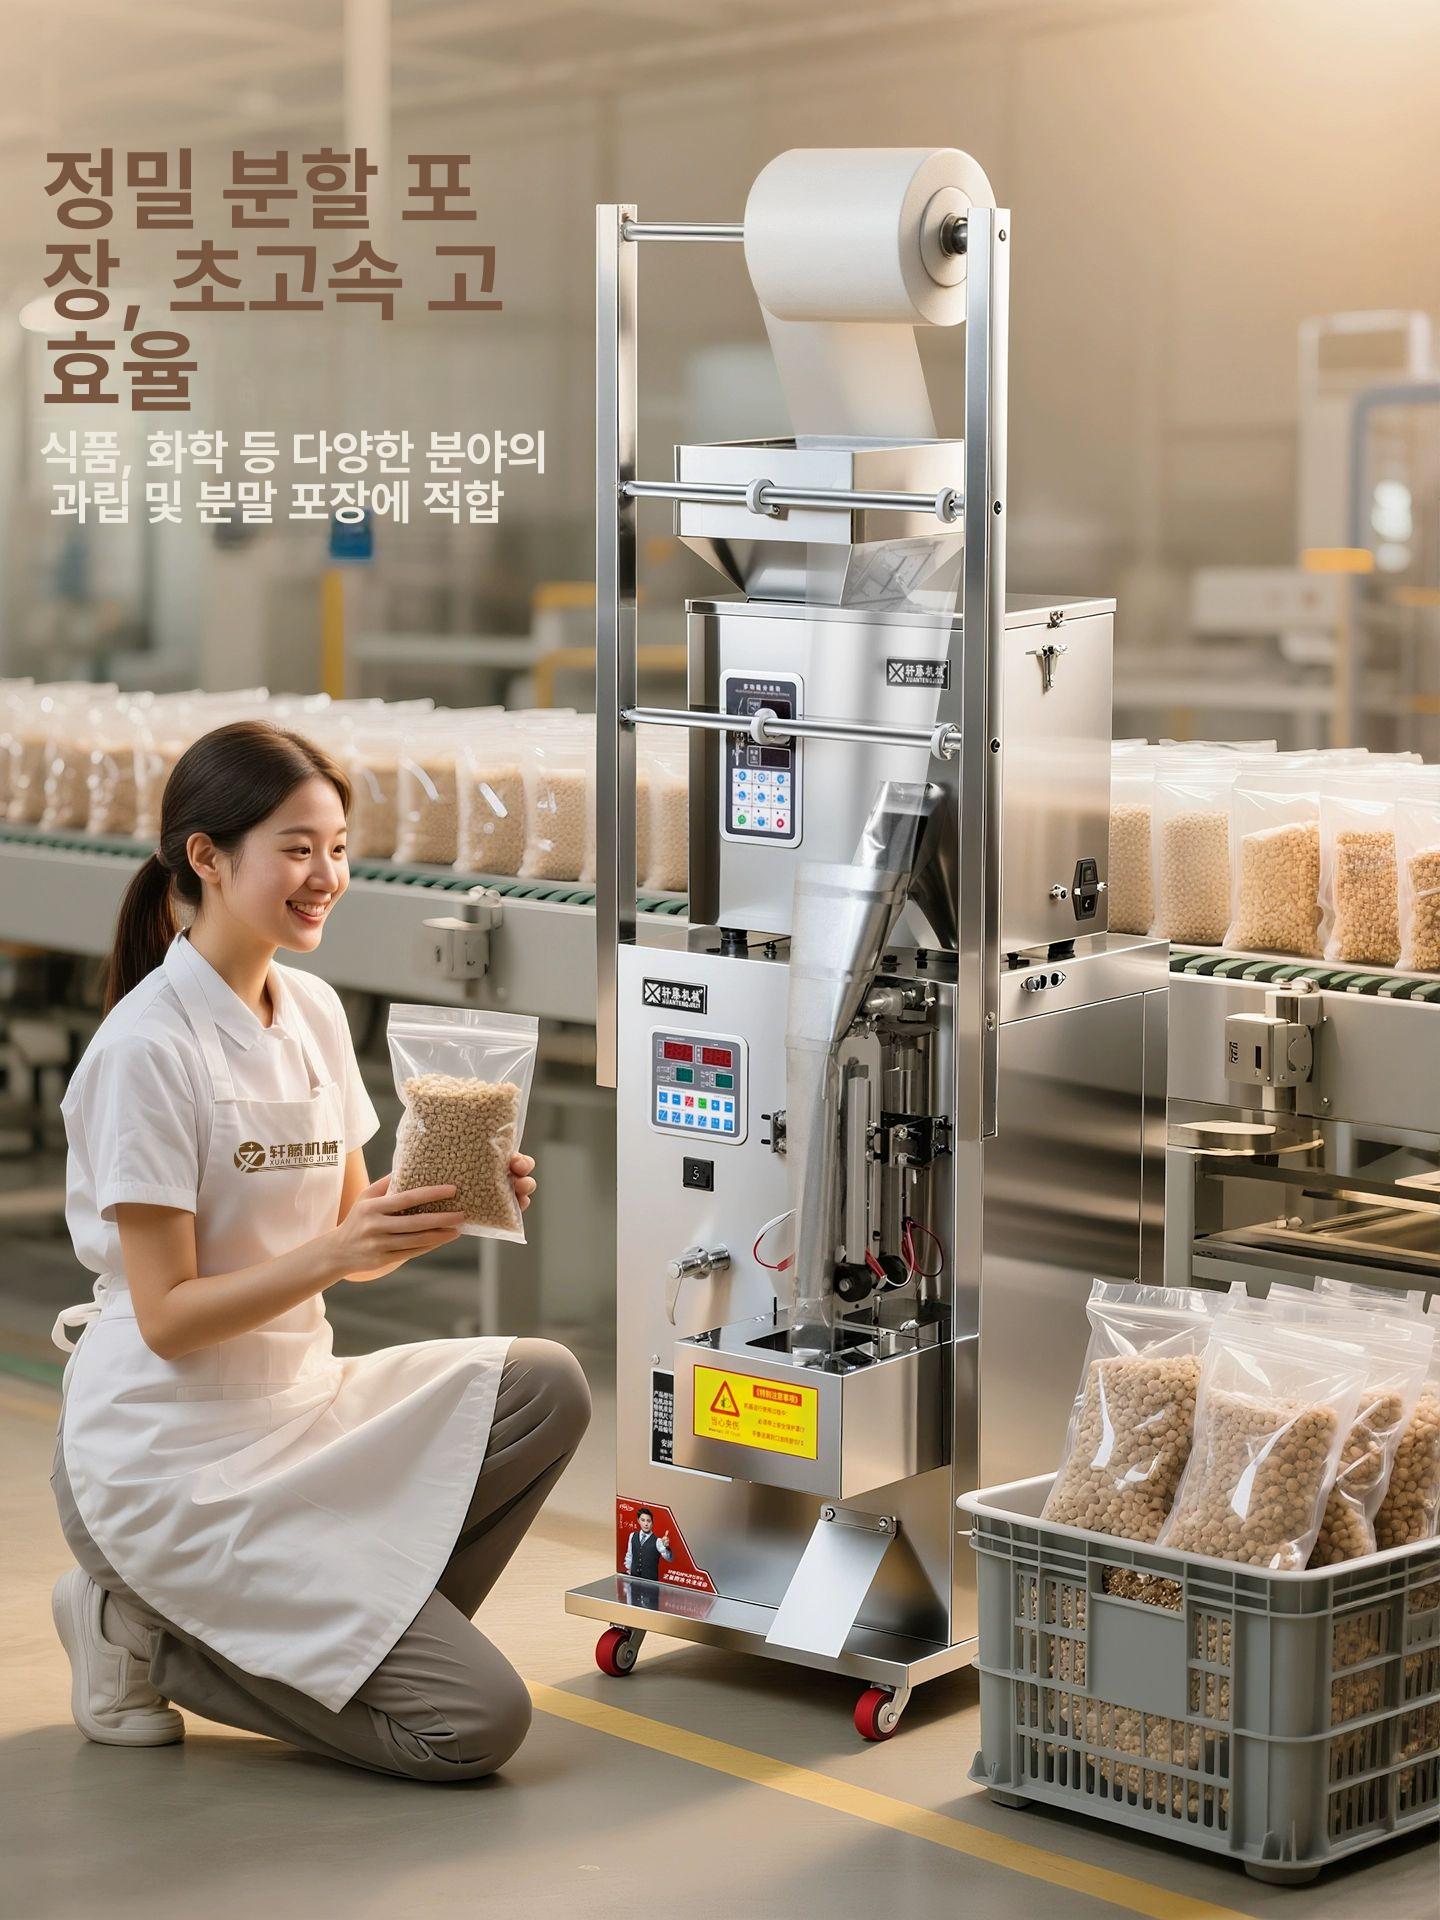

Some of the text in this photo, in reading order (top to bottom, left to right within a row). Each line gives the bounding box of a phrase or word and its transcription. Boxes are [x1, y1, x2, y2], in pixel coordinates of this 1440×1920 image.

[269, 1140, 338, 1158] 轩藤机械
[269, 1158, 291, 1166] XUAN
[293, 1156, 314, 1164] TENG
[326, 1154, 339, 1162] XIE
